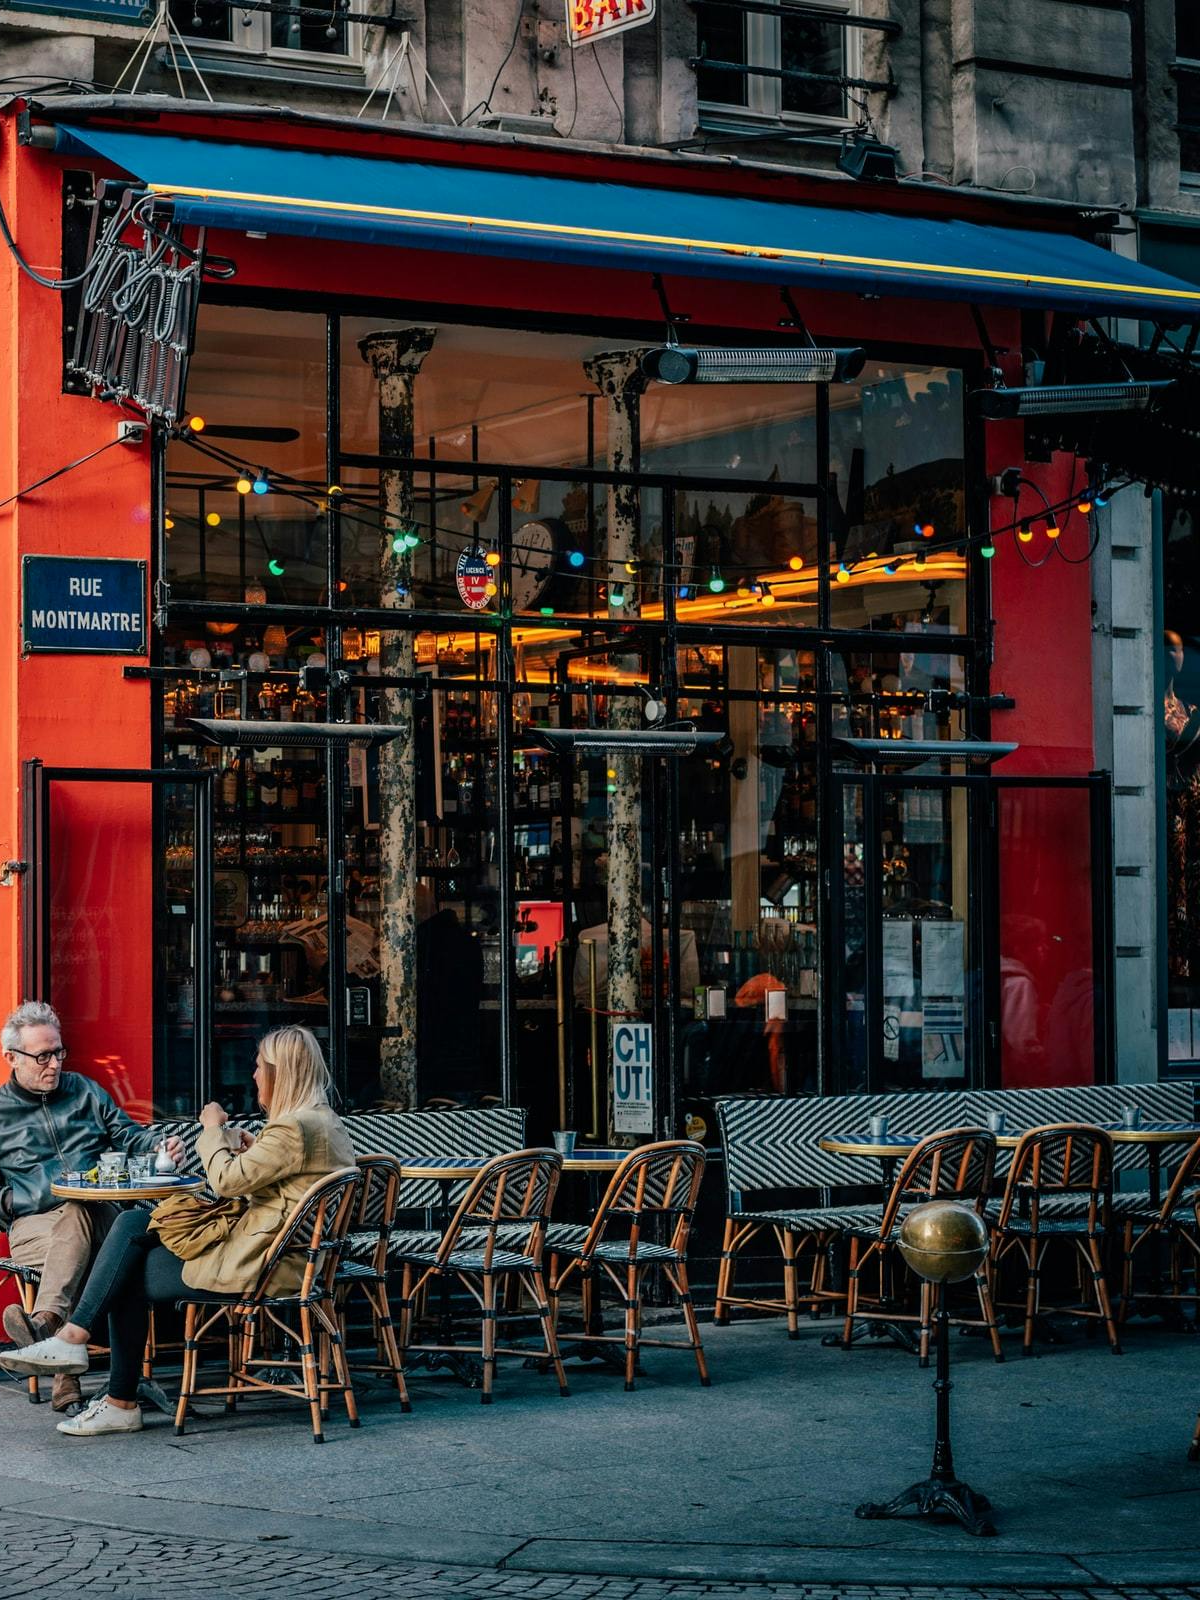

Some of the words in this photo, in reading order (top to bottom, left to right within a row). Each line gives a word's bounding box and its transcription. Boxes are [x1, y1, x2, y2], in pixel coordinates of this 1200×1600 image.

[69, 577, 103, 597] RUE
[471, 576, 480, 585] IV
[31, 609, 141, 632] MONTMARTRE
[615, 1027, 650, 1063] CH
[615, 1065, 651, 1101] UT!
